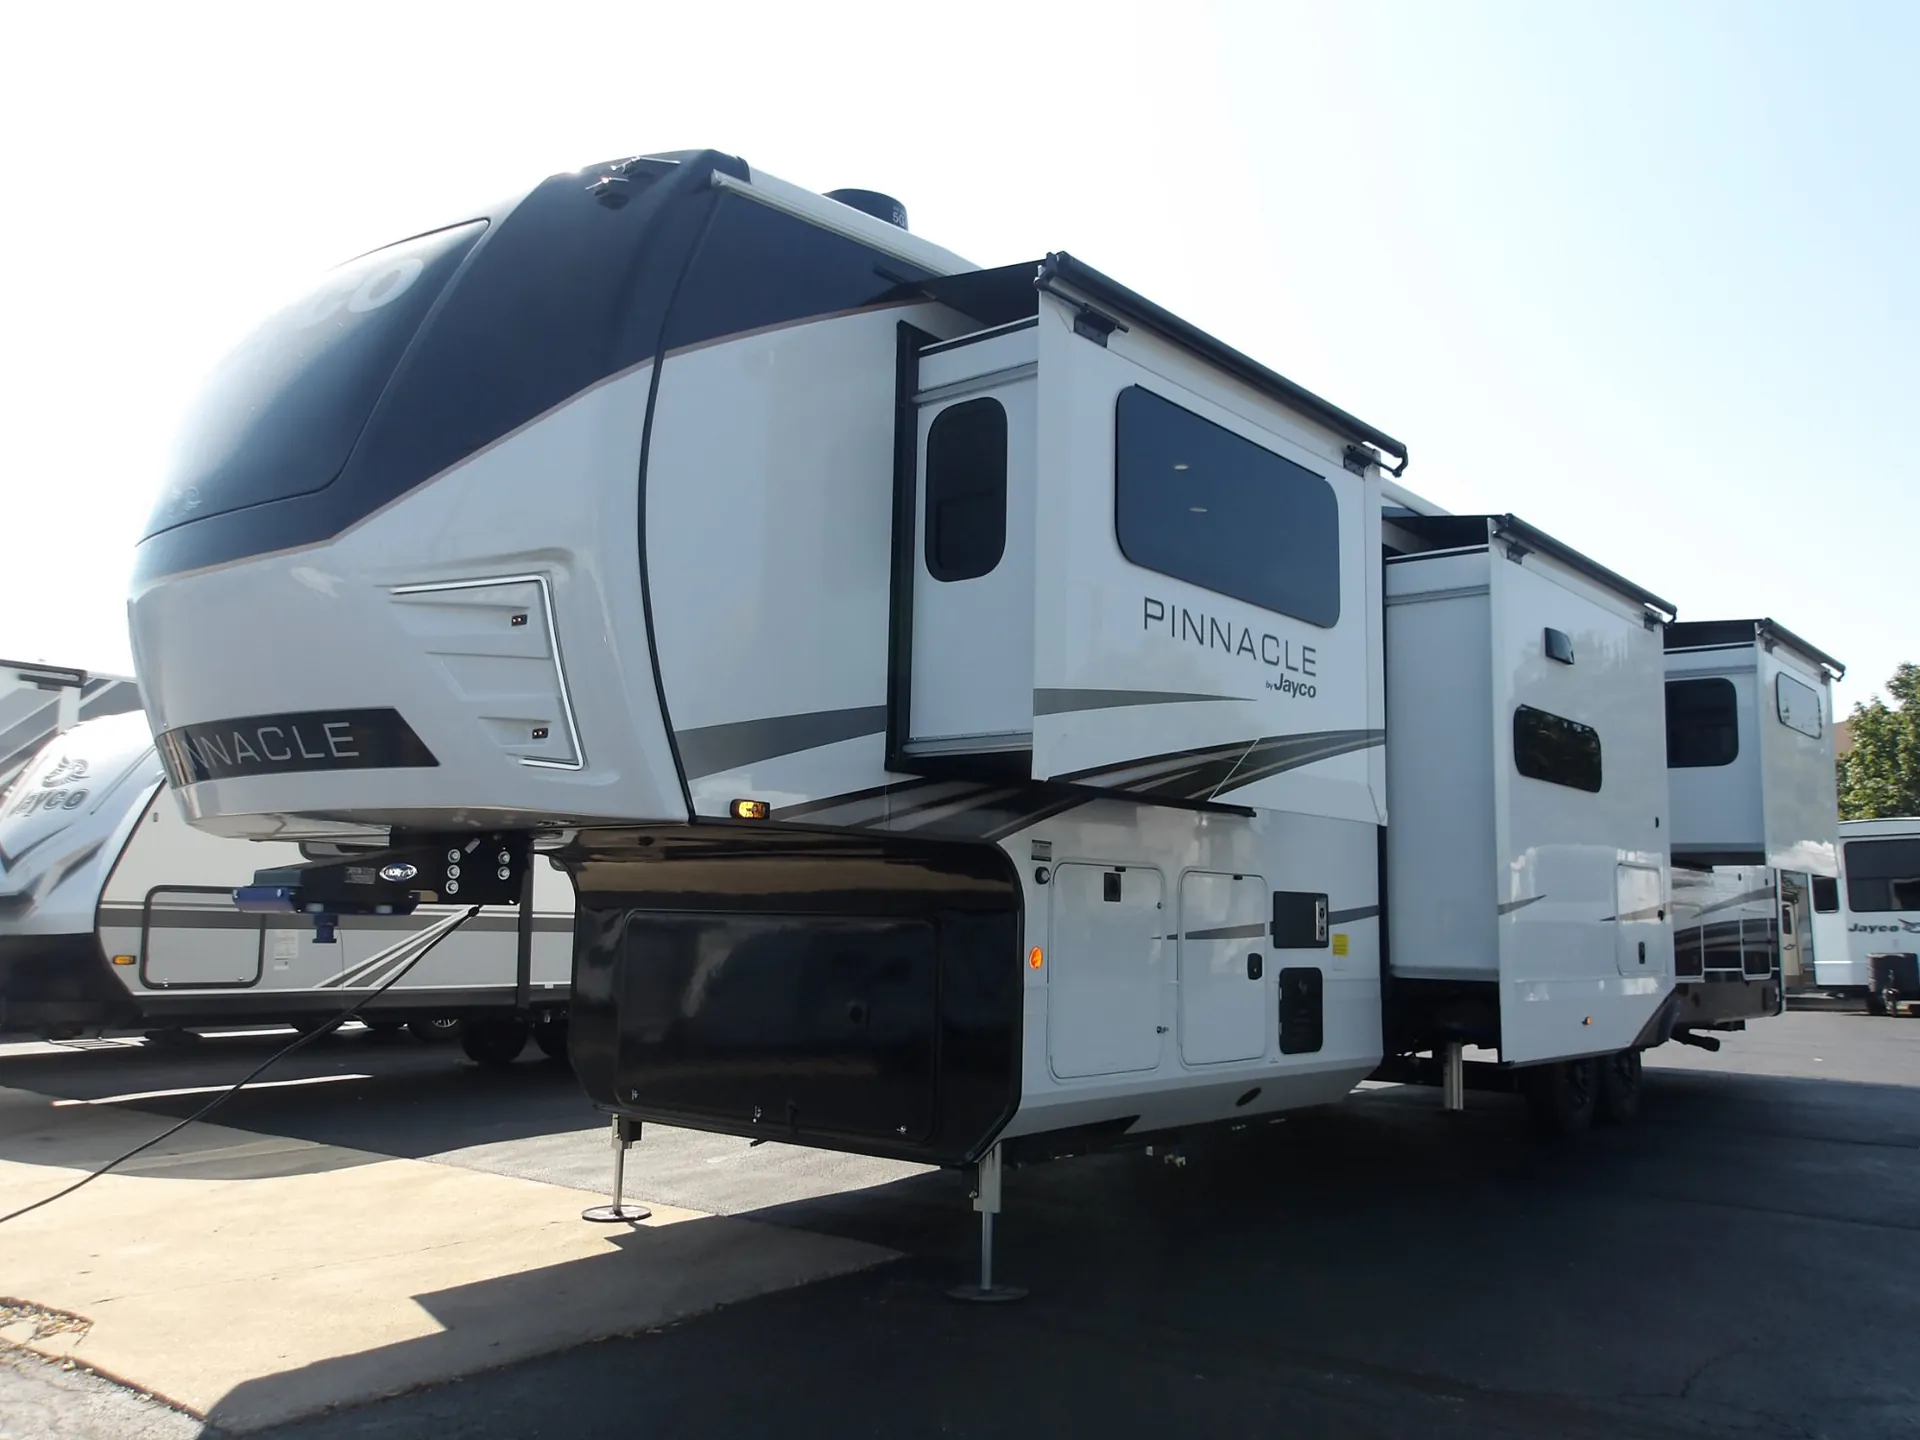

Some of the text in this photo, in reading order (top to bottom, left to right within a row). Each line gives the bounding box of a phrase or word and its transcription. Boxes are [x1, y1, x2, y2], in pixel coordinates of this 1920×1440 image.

[892, 210, 905, 227] 5G
[1144, 596, 1317, 677] PINNACLE
[1265, 672, 1317, 699] by Jayco
[178, 721, 360, 771] NNACLE
[1848, 923, 1899, 934] Jayco
